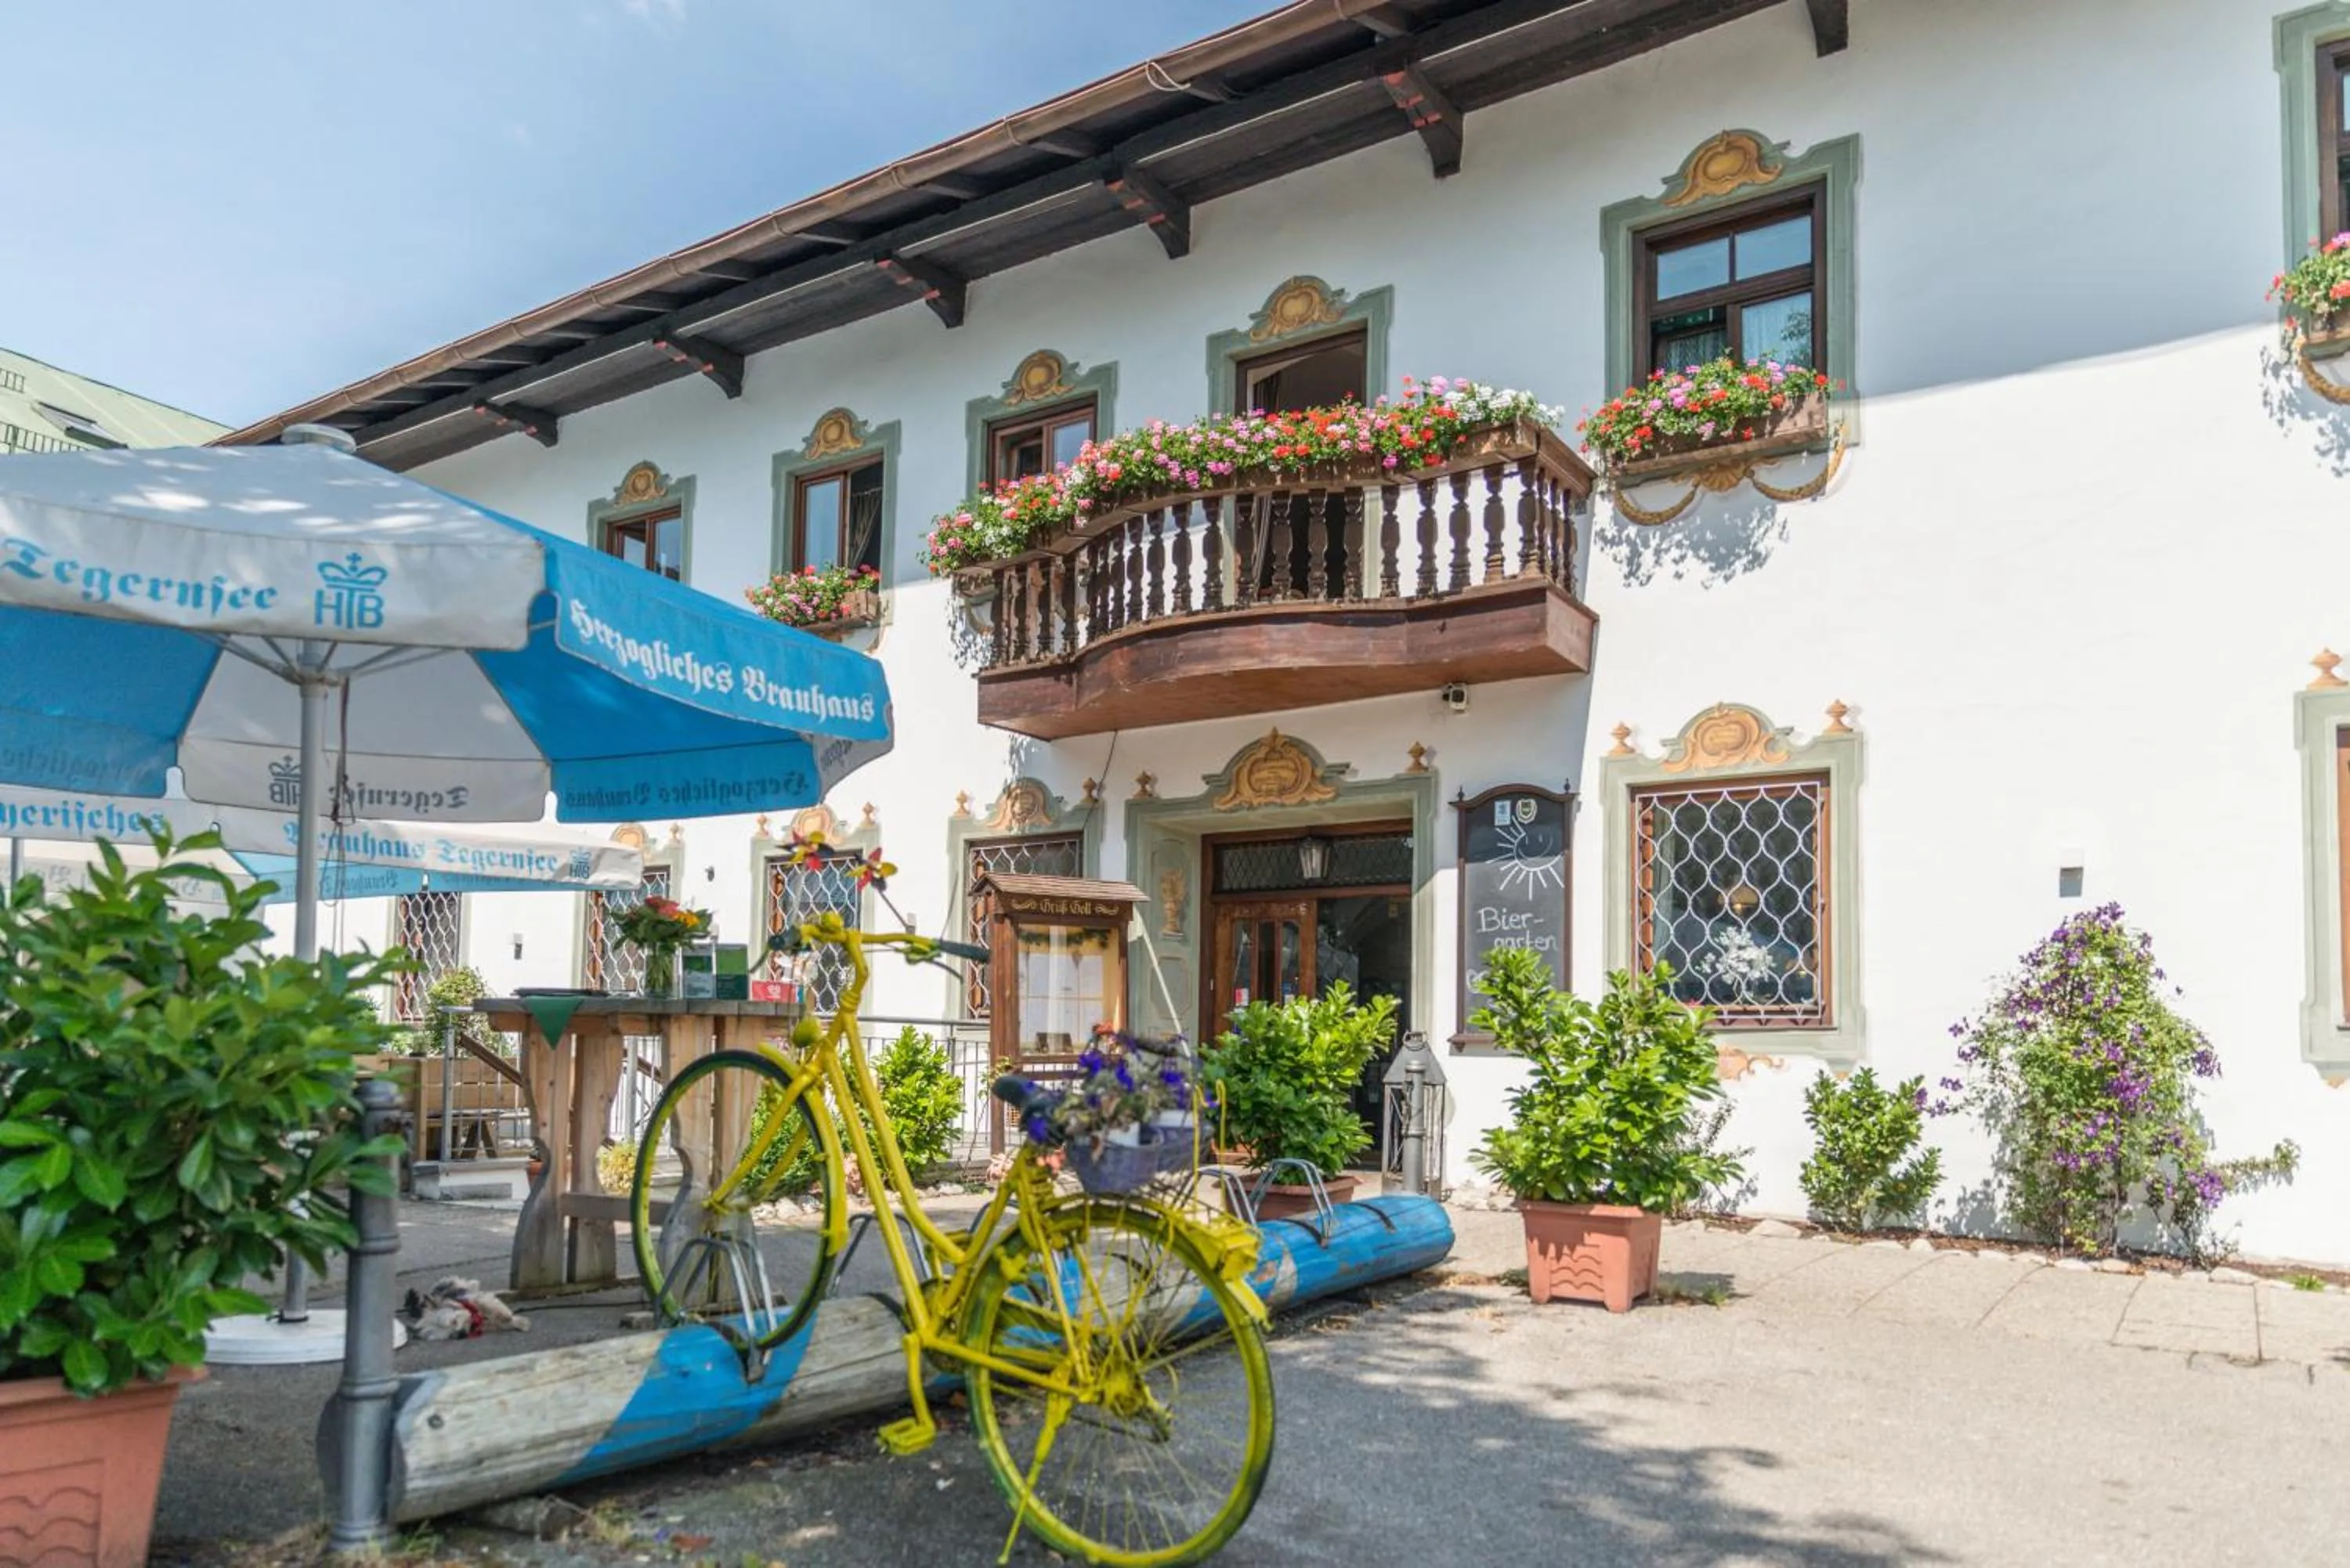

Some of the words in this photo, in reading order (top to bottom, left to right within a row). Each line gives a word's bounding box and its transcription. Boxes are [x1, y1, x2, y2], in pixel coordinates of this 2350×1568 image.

[1, 538, 278, 616] Tegernsee
[315, 591, 384, 630] HTB
[570, 600, 734, 694] Herzogliches
[742, 666, 875, 724] Brauhaus
[436, 838, 558, 875] Tegernsee
[1477, 906, 1544, 932] Bier-
